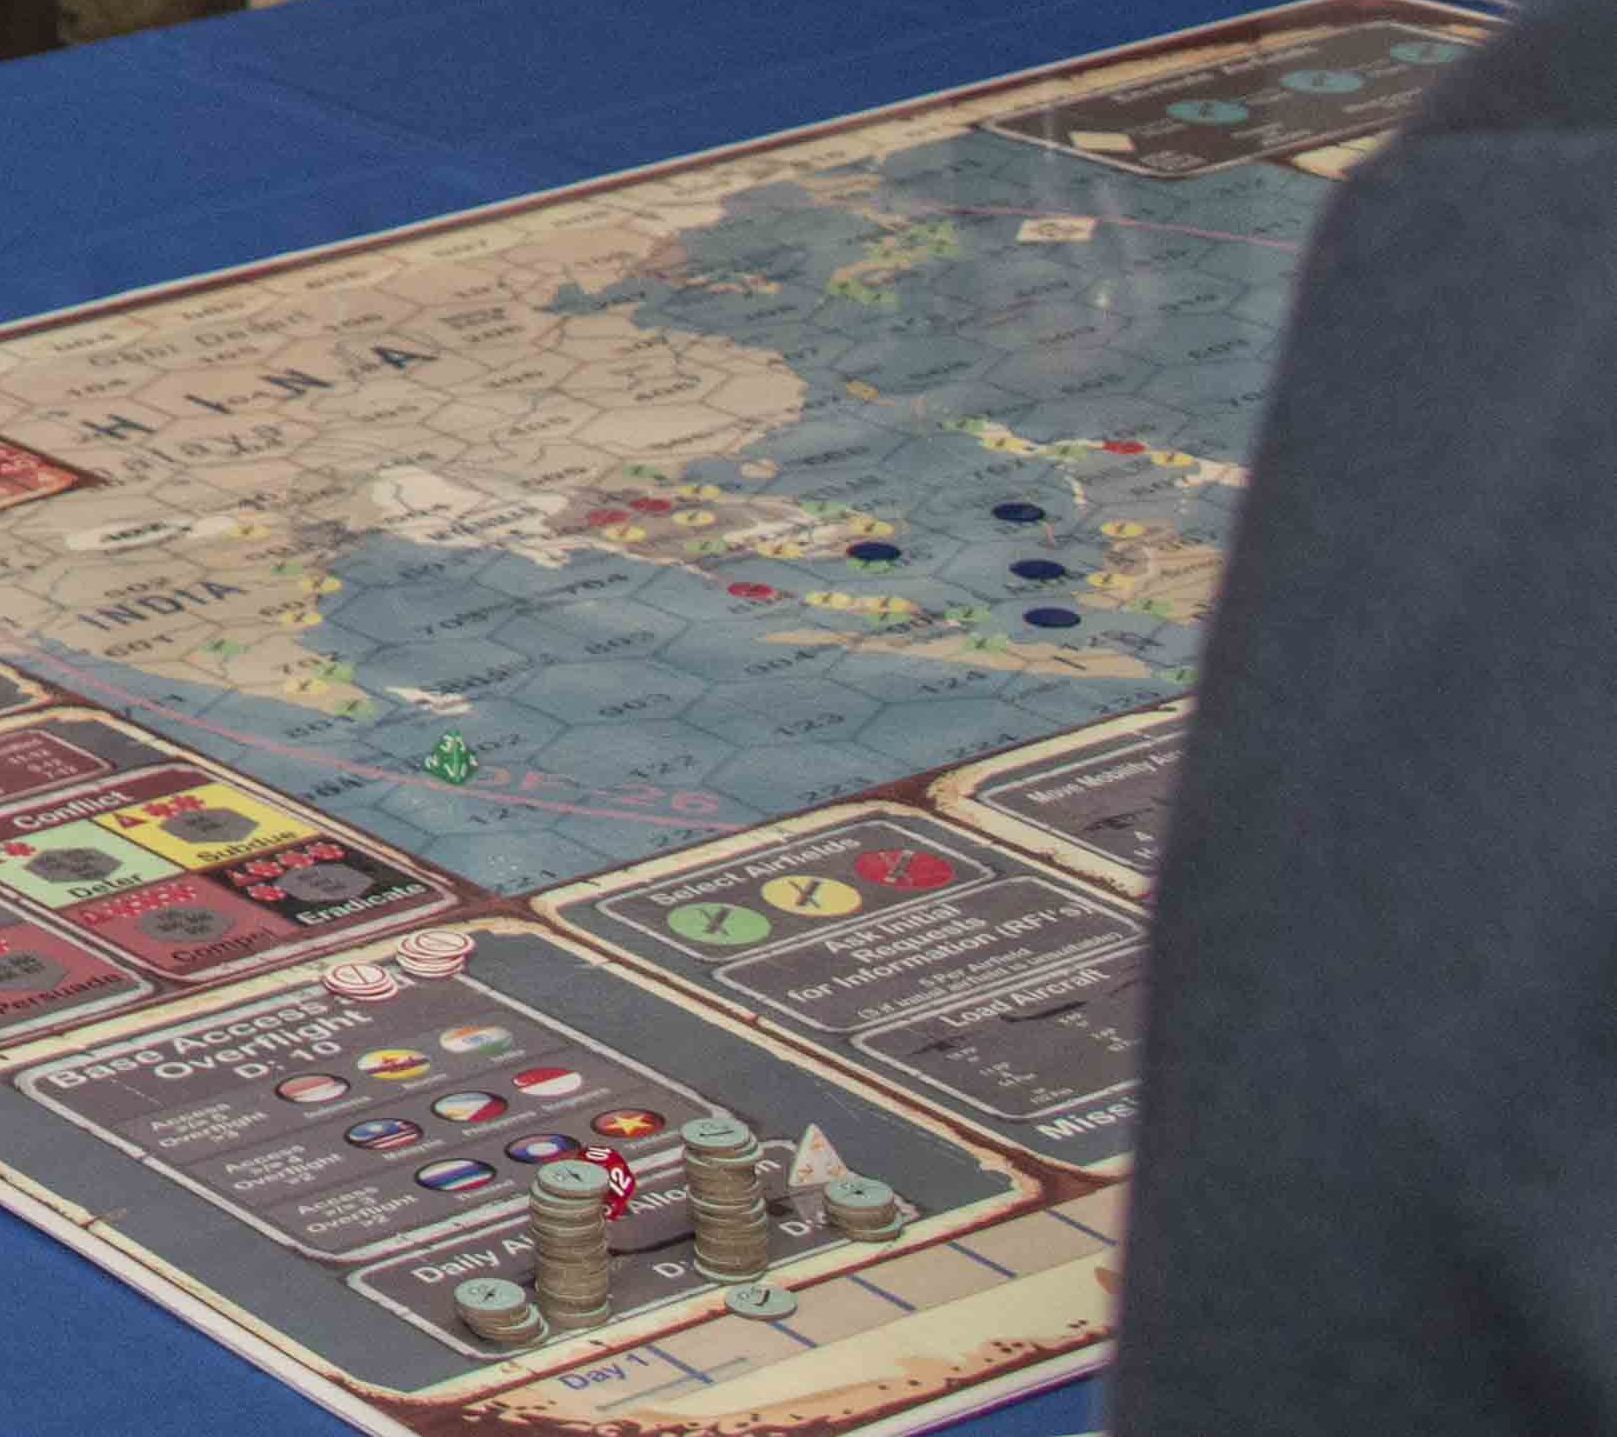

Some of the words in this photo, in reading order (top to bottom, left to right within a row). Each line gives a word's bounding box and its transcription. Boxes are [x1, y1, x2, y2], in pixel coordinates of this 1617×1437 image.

[78, 579, 245, 629] INDIA
[7, 789, 139, 830] Conflict
[191, 828, 300, 862] Subdue
[65, 871, 149, 898] Deter
[648, 874, 750, 905] Select
[735, 837, 867, 876] Airfields
[293, 883, 433, 925] Eradicate
[169, 928, 285, 964] Compel
[818, 929, 888, 952] Ask
[873, 904, 966, 933] Initial
[847, 916, 997, 962] Requests
[784, 982, 839, 1002] for
[824, 931, 1010, 988] Information
[963, 947, 1038, 971] Airfield
[937, 999, 1017, 1027] Load
[1003, 968, 1115, 1004] Aircraft
[45, 1048, 169, 1089] Base
[161, 1000, 337, 1054] Access
[144, 1008, 381, 1081] Overflight
[229, 1057, 284, 1079] D:
[286, 1039, 346, 1061] 10
[609, 1167, 632, 1198] 12
[408, 1247, 506, 1284] Daily
[558, 1360, 626, 1391] Day
